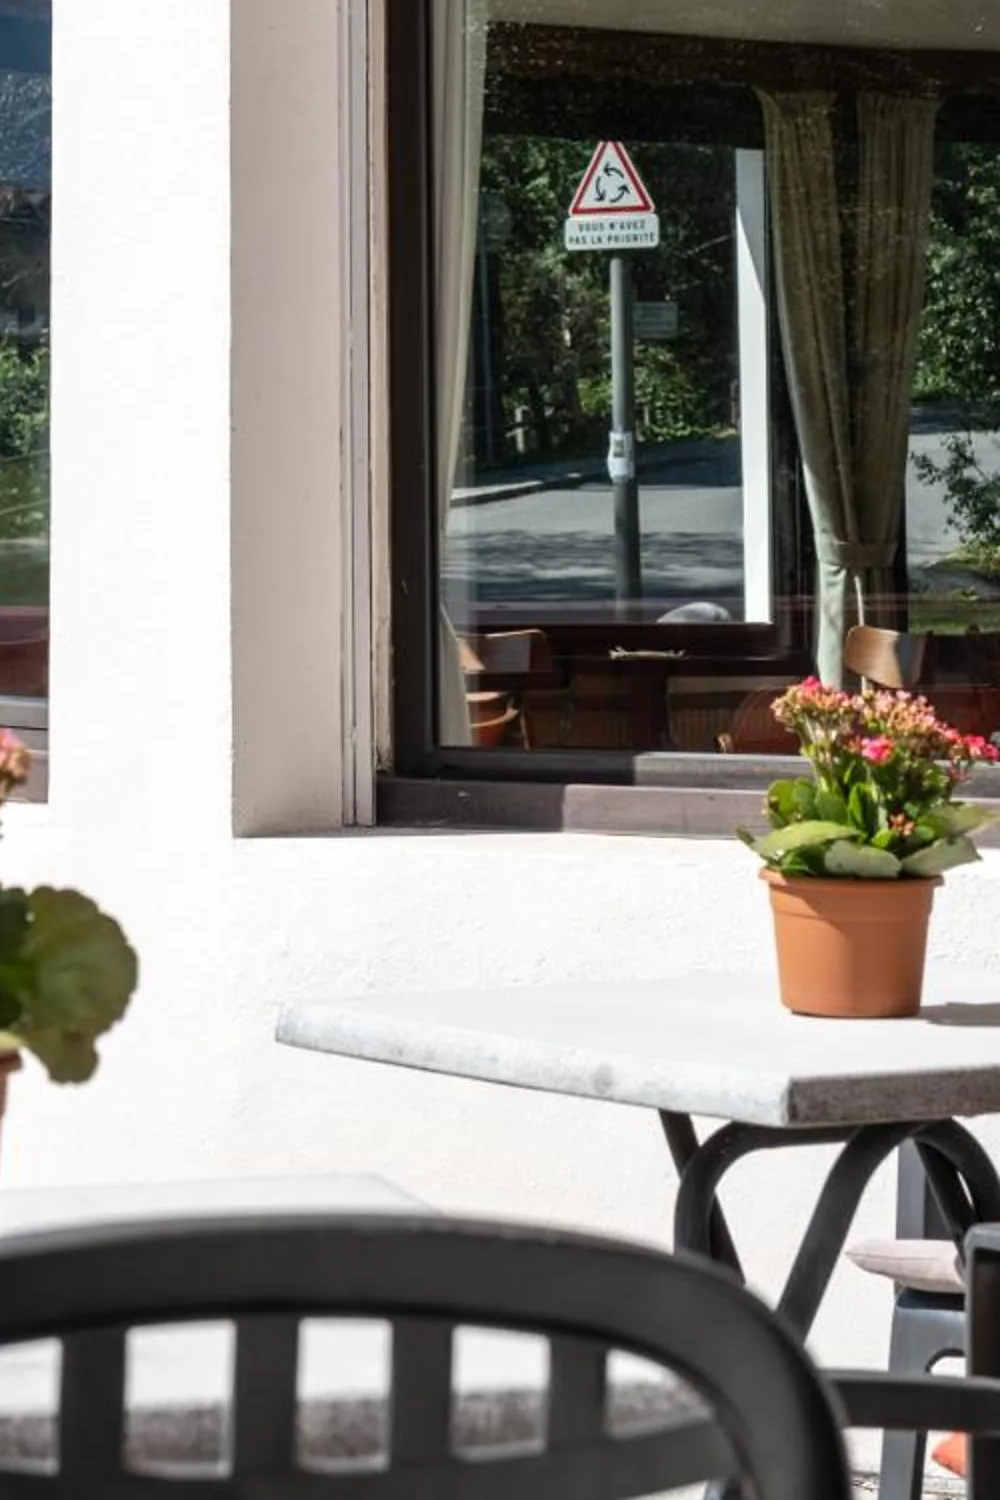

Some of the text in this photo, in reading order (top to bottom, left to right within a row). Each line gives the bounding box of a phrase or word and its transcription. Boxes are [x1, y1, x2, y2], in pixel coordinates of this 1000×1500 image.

[578, 221, 604, 232] VOUS
[569, 234, 587, 245] PAS
[591, 234, 603, 245] LA
